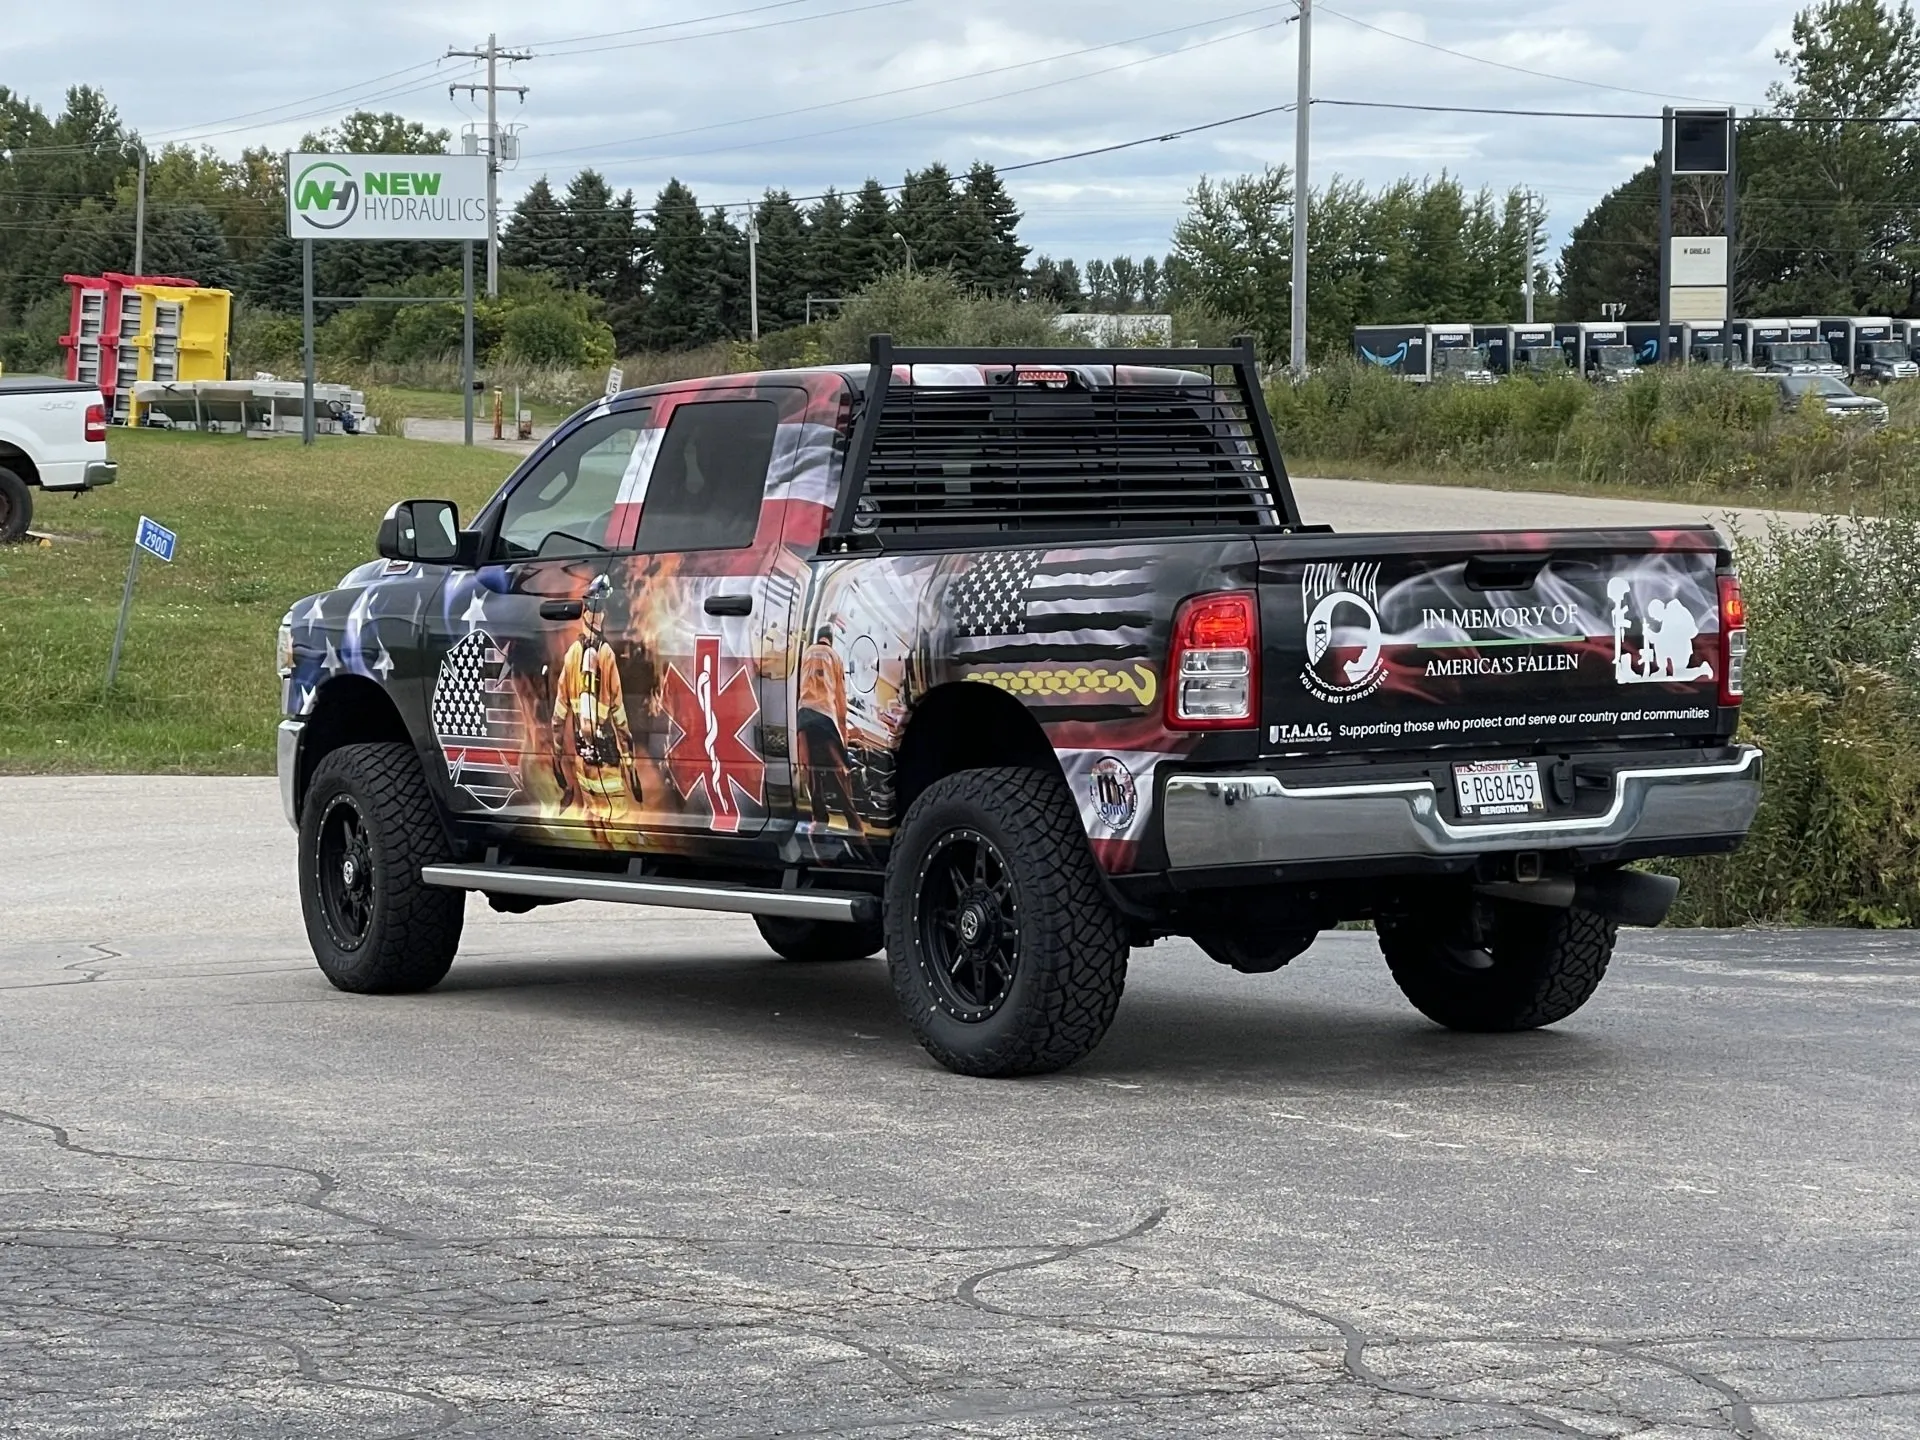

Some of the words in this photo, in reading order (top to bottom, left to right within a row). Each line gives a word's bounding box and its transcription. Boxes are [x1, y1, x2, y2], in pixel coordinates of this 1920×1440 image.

[364, 172, 442, 196] NEW
[364, 197, 486, 222] HYDRAULICS
[608, 382, 618, 394] 15
[144, 530, 168, 555] 2900
[1301, 562, 1343, 624] POW
[1347, 561, 1382, 614] MIA
[1422, 608, 1446, 629] IN
[1452, 605, 1546, 629] MEMORY
[1551, 603, 1579, 625] OF
[1424, 656, 1514, 677] AMERICA'S
[1517, 653, 1580, 673] FALLEN
[1299, 671, 1313, 690] YOU
[1310, 688, 1327, 701] ARE
[1327, 695, 1344, 704] NOT
[1346, 668, 1389, 703] FORGOTTEN
[1279, 722, 1332, 739] T.A.A.G.
[1339, 721, 1401, 739] Supporting
[1403, 720, 1435, 733] those
[1437, 718, 1461, 731] who
[1462, 716, 1502, 732] protect
[1504, 714, 1526, 727] and
[1528, 715, 1557, 725] serve
[1558, 714, 1578, 724] our
[1578, 710, 1619, 725] country
[1620, 709, 1642, 722] and
[1643, 707, 1710, 720] communities
[1473, 774, 1535, 803] RG8459
[1480, 803, 1529, 815] BERGSTROM
